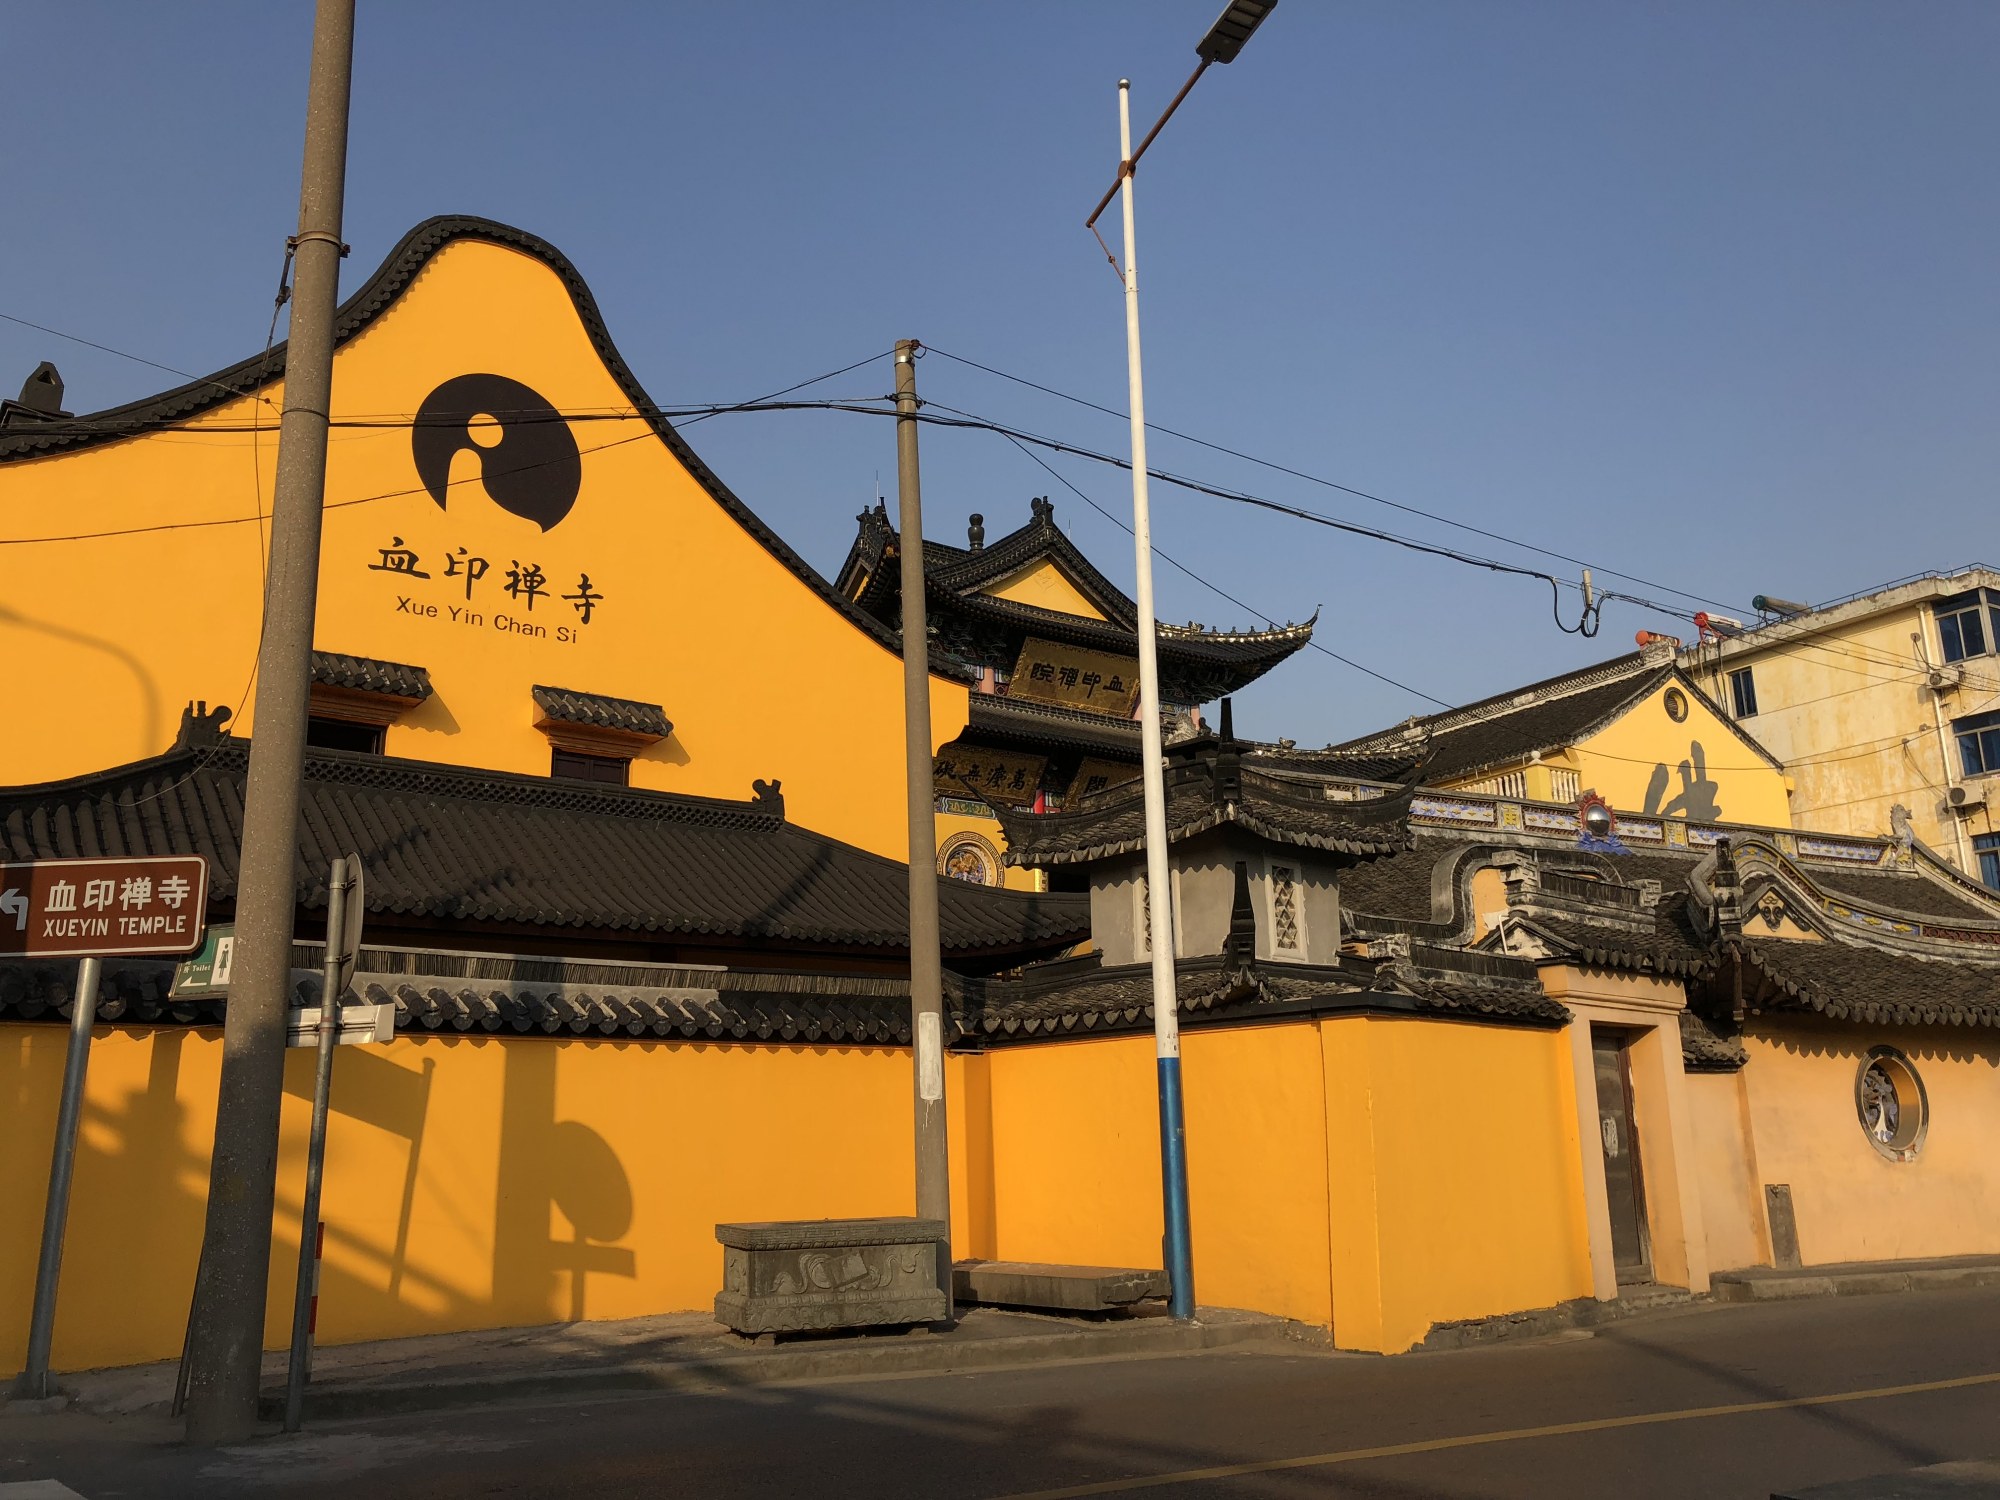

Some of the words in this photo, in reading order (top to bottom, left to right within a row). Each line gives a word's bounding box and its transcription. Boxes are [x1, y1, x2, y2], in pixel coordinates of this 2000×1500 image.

[367, 536, 604, 625] 血印禅寺
[395, 595, 438, 618] Xue
[447, 605, 483, 627] Yin
[493, 613, 547, 639] Chan
[555, 626, 577, 644] Si
[44, 875, 191, 913] 血印禅寺
[42, 917, 109, 938] XUEYIN
[118, 914, 187, 936] TEMPLE
[192, 964, 211, 972] Toilet
